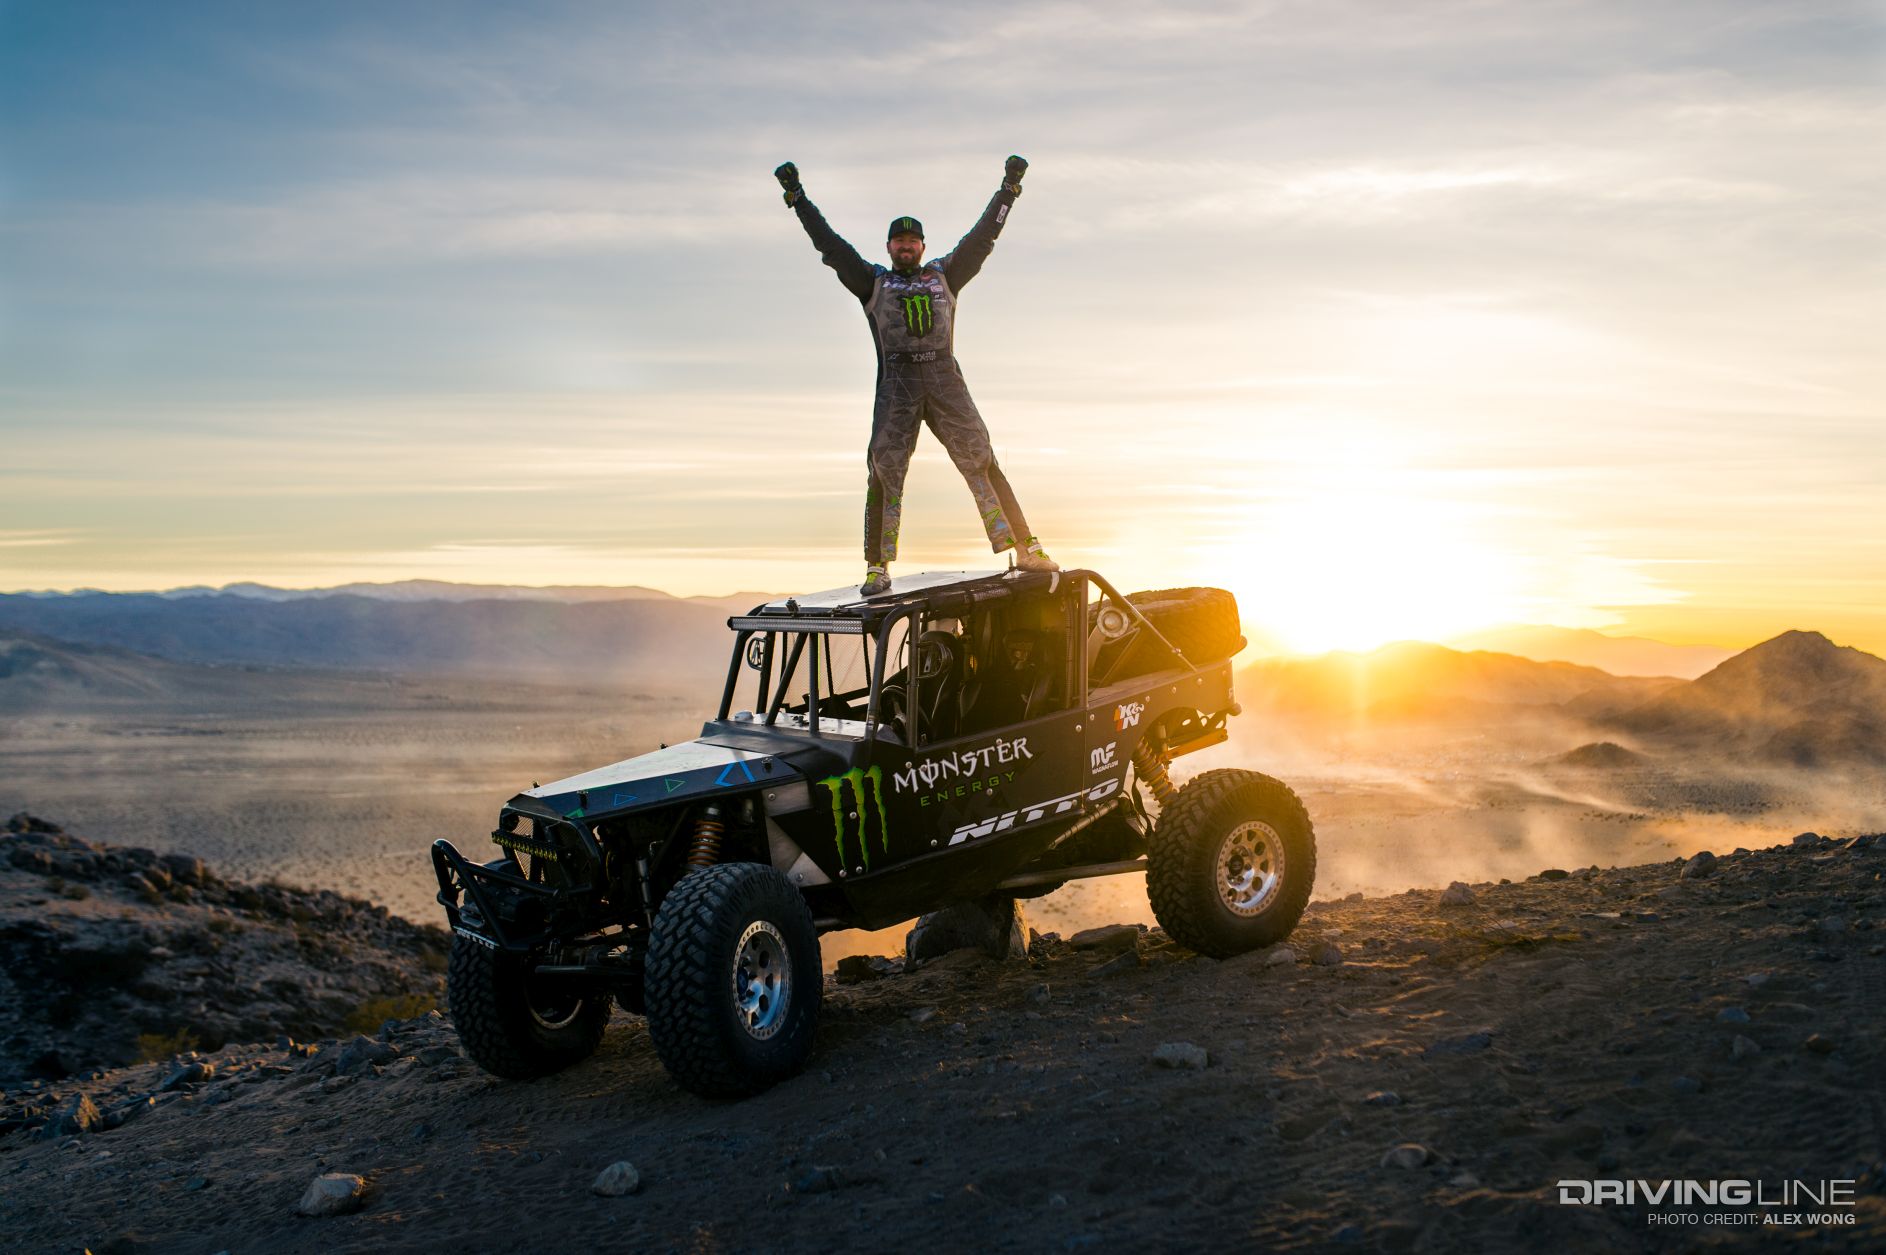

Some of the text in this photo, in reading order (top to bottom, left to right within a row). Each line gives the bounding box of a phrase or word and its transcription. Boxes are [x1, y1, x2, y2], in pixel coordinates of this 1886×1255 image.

[892, 736, 1033, 794] MONSTER
[920, 771, 1016, 807] ENERGY
[948, 777, 1119, 846] NITTO
